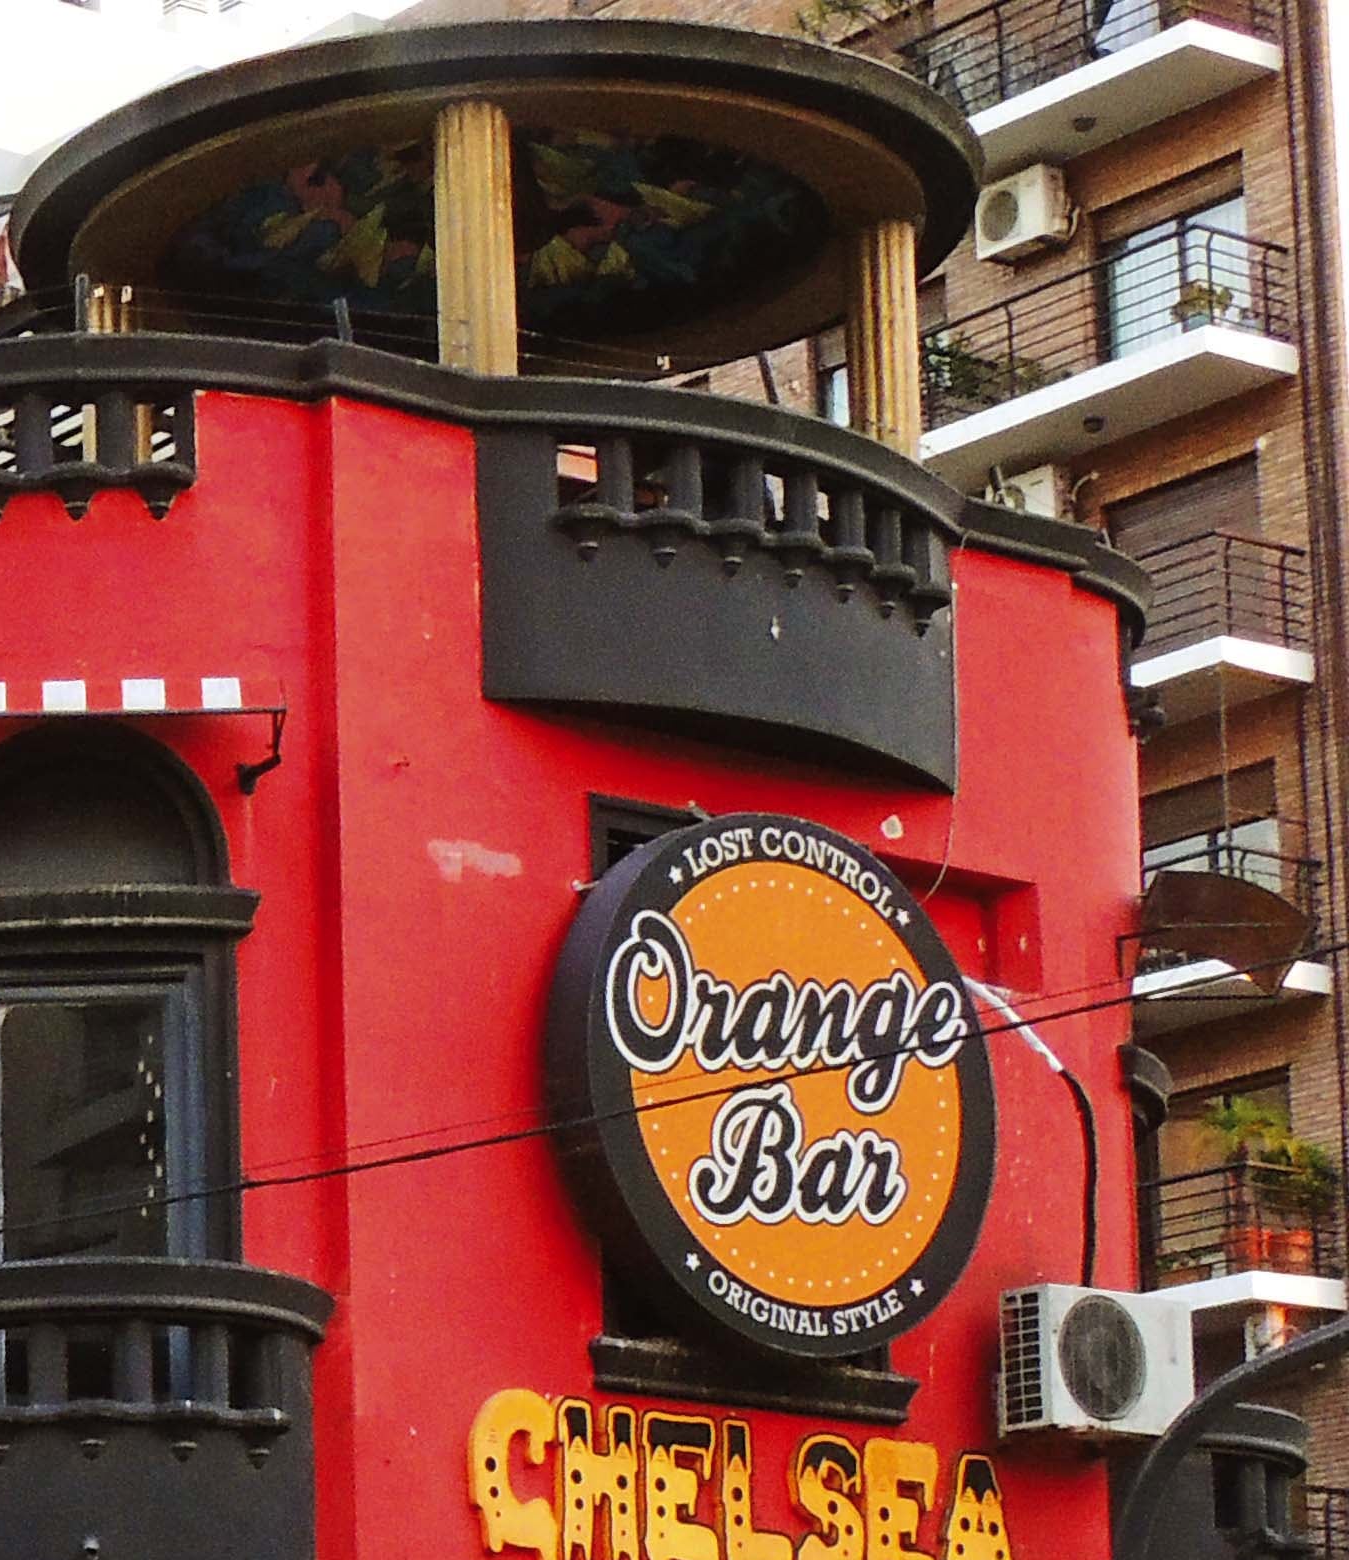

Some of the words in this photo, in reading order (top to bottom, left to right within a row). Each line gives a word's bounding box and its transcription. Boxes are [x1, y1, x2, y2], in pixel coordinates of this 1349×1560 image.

[682, 828, 754, 877] LOST
[759, 825, 895, 921] CONTROL
[606, 909, 968, 1113] Orange
[689, 1084, 906, 1225] Bar
[707, 1270, 829, 1337] ORIGINAL
[831, 1289, 904, 1337] STYLE
